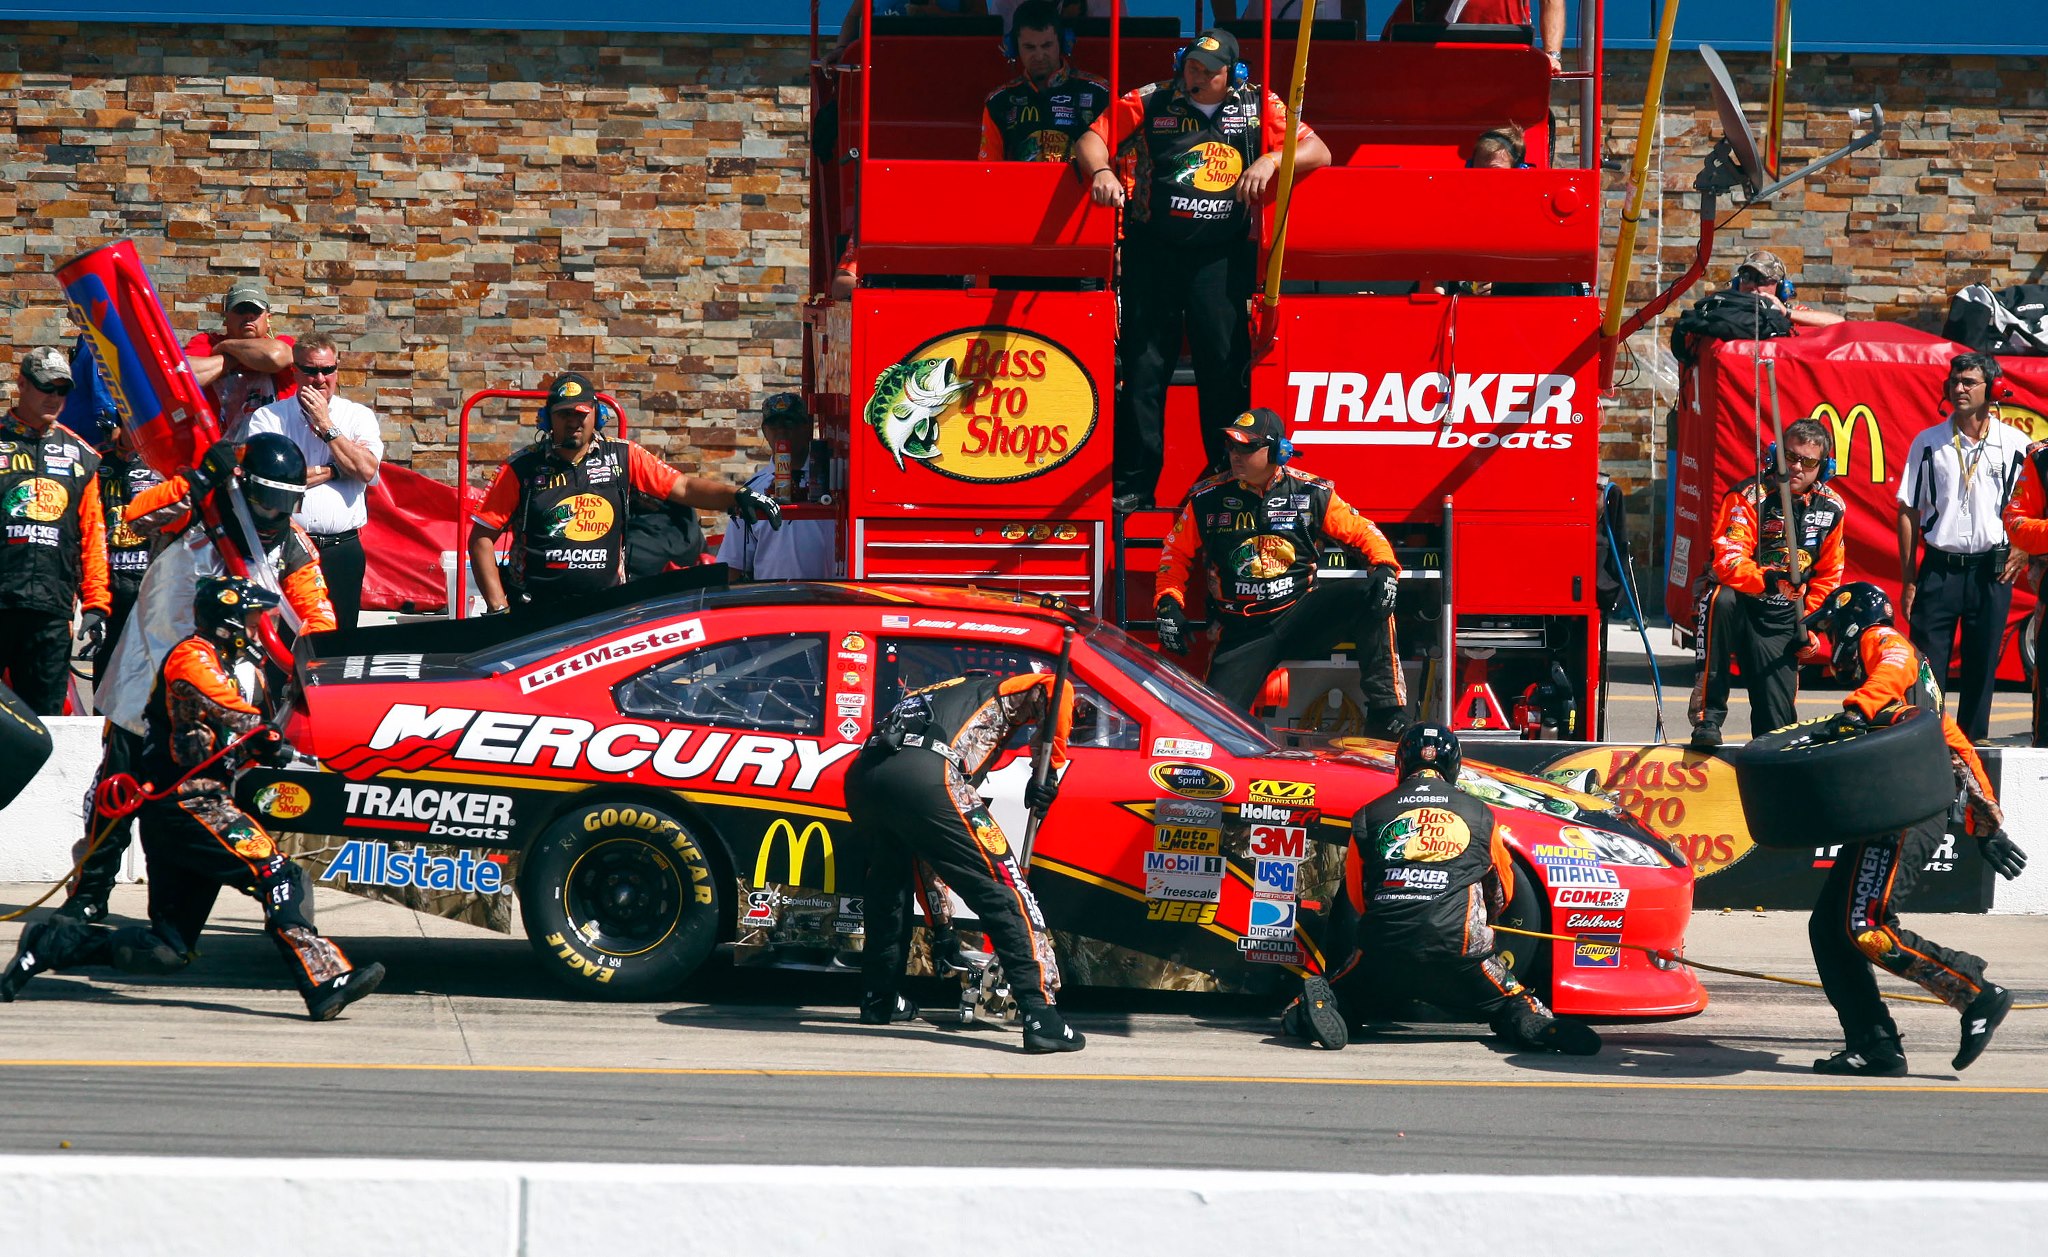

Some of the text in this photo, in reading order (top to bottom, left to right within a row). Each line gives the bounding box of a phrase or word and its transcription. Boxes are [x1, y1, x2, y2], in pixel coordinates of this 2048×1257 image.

[1205, 142, 1235, 158] Bass
[1205, 157, 1227, 170] Pro
[1204, 170, 1238, 186] Shops
[1170, 196, 1233, 212] TRACKER
[1193, 211, 1230, 219] boats
[959, 338, 1047, 379] Bass
[962, 378, 1028, 416] Pro
[1287, 371, 1577, 425] TRACKER
[960, 415, 1069, 465] Shops
[1437, 425, 1573, 449] boats
[36, 479, 59, 491] Bass
[38, 490, 53, 502] Pro
[574, 496, 603, 509] Bass
[36, 502, 64, 516] Shops
[575, 508, 596, 520] Pro
[574, 520, 610, 535] Shops
[1258, 535, 1284, 549] Bass
[107, 550, 149, 564] ACKER
[545, 549, 608, 562] TRACKER
[568, 562, 607, 570] boats
[1235, 577, 1294, 595] TRACKER
[1256, 588, 1294, 601] boats
[526, 627, 696, 689] LiftMaster
[368, 703, 864, 791] MERCURY
[1173, 768, 1202, 776] NASCAR
[1602, 750, 1710, 792] Bass
[1178, 776, 1206, 786] Sprint
[278, 784, 300, 795] Bass
[278, 793, 294, 803] Pro
[343, 783, 514, 826] TRACKER
[1248, 793, 1315, 807] MECHANIX WEAR
[1397, 795, 1449, 804] JACOBSEN
[276, 803, 304, 816] Shops
[1186, 807, 1217, 819] LIGHT
[1240, 803, 1291, 826] Holley
[1616, 788, 1687, 828] Pro
[1165, 816, 1208, 825] POLE
[1417, 808, 1456, 825] Bass
[427, 820, 510, 840] boats
[1173, 829, 1208, 841] Auto
[1418, 824, 1445, 837] Pro
[1169, 838, 1215, 851] Meter
[1250, 826, 1305, 858] 3M
[1416, 837, 1464, 856] Shops
[1667, 833, 1736, 865] ops
[584, 808, 713, 906] GOODYEAR
[1535, 844, 1597, 861] MOOG
[319, 840, 502, 894] Allstate
[1147, 853, 1216, 872] Mobil 1
[1257, 861, 1295, 892] USG
[1384, 867, 1449, 884] TRACKER
[1548, 865, 1617, 884] MAHLE
[1871, 849, 1891, 899] boats
[1163, 886, 1218, 899] freescale
[1404, 881, 1447, 890] boats
[1852, 846, 1881, 931] TRACKER
[781, 895, 832, 908] SapientNitro
[1255, 891, 1293, 900] SHEETROCK
[1560, 890, 1613, 904] COMP
[1146, 900, 1219, 925] JEGS
[1566, 913, 1623, 929] Edelbrock
[1250, 926, 1293, 938] DIRECTV
[1240, 938, 1294, 953] LINCOLN
[1578, 946, 1617, 955] SUNOCO
[546, 932, 616, 984] EAGLE
[1251, 952, 1298, 963] WELDERS
